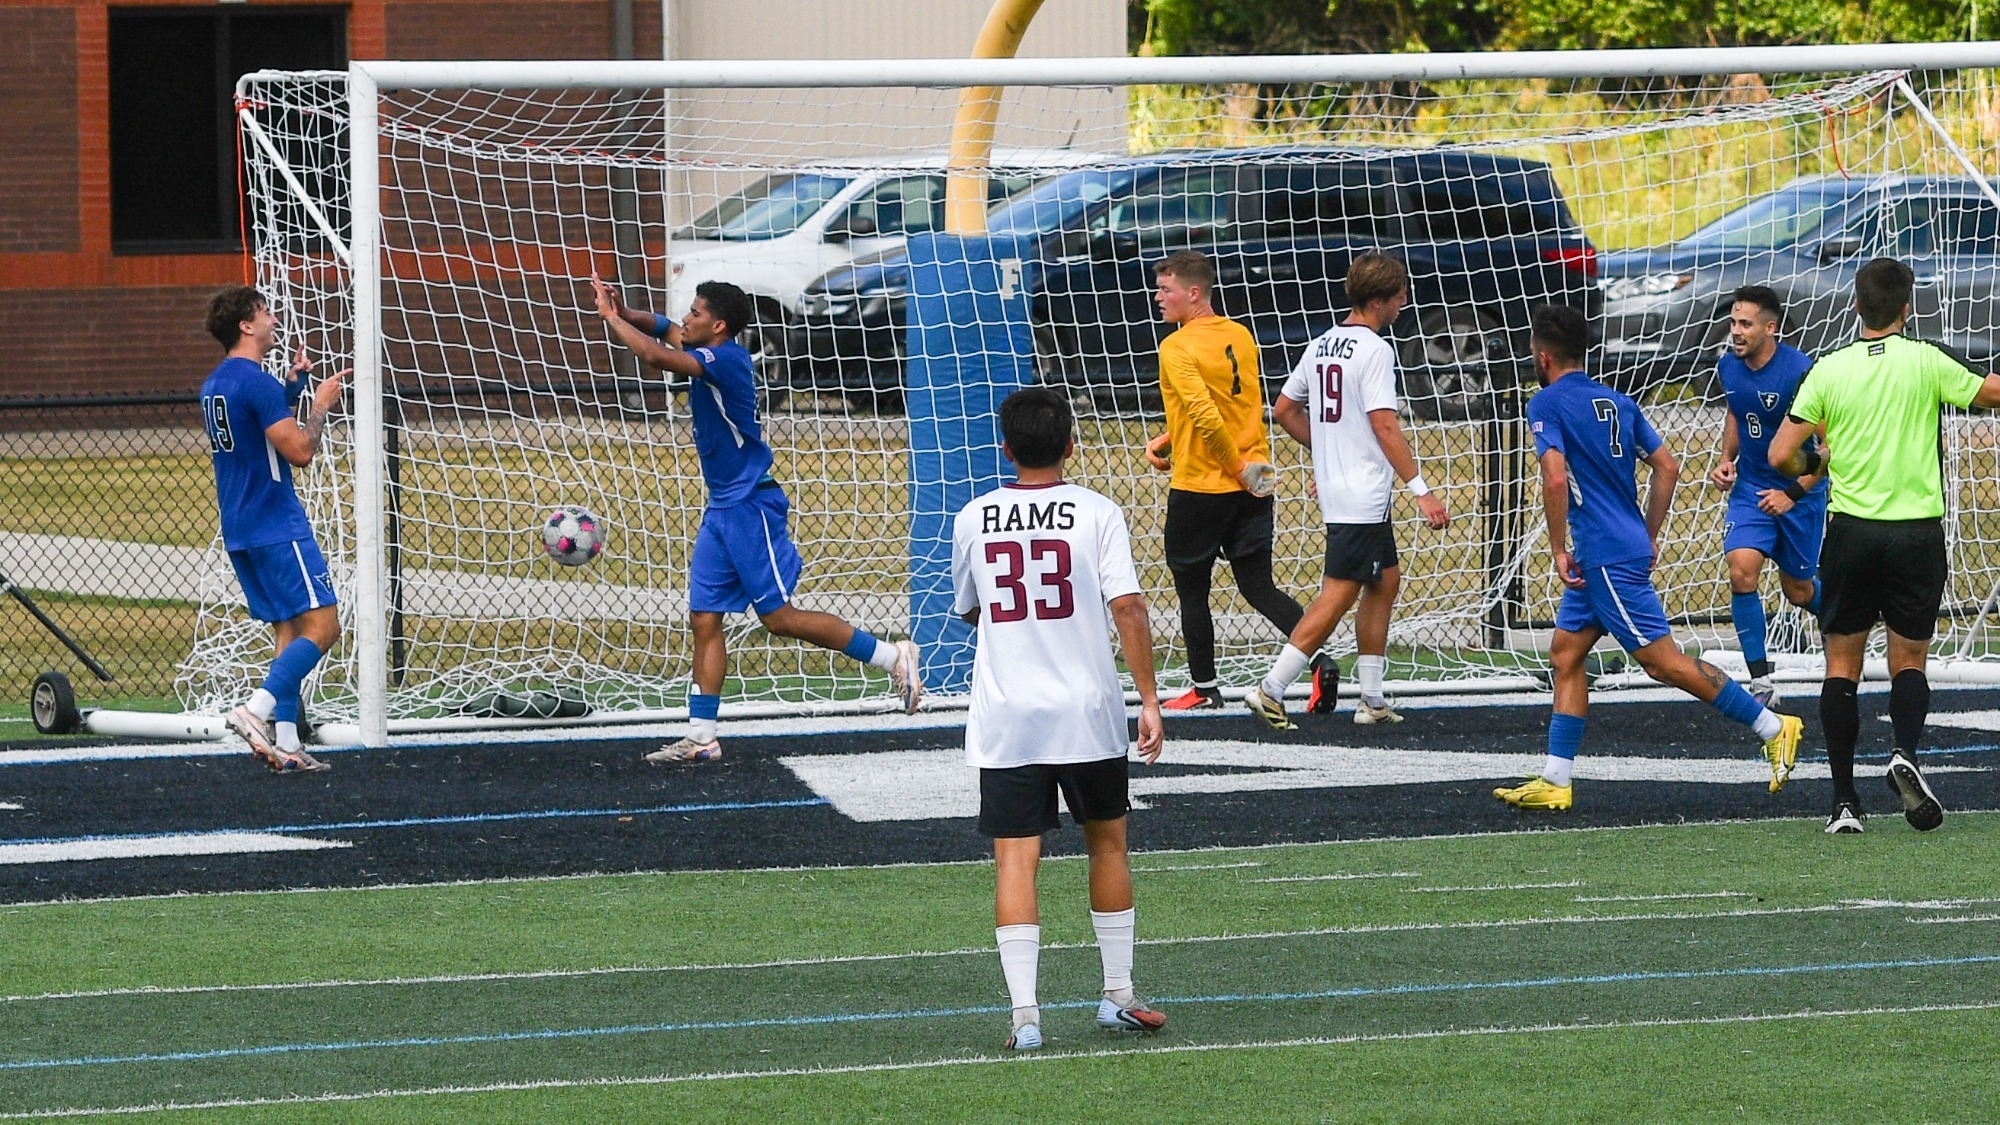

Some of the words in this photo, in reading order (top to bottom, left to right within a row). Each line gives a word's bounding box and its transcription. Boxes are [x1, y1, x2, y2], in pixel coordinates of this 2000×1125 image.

[1000, 258, 1021, 300] F
[1225, 344, 1241, 396] 1
[1316, 364, 1343, 423] 19
[203, 395, 235, 453] 19
[1592, 398, 1623, 458] 7
[1746, 412, 1762, 439] 6
[981, 501, 1076, 534] RAMS
[984, 539, 1075, 624] 33
